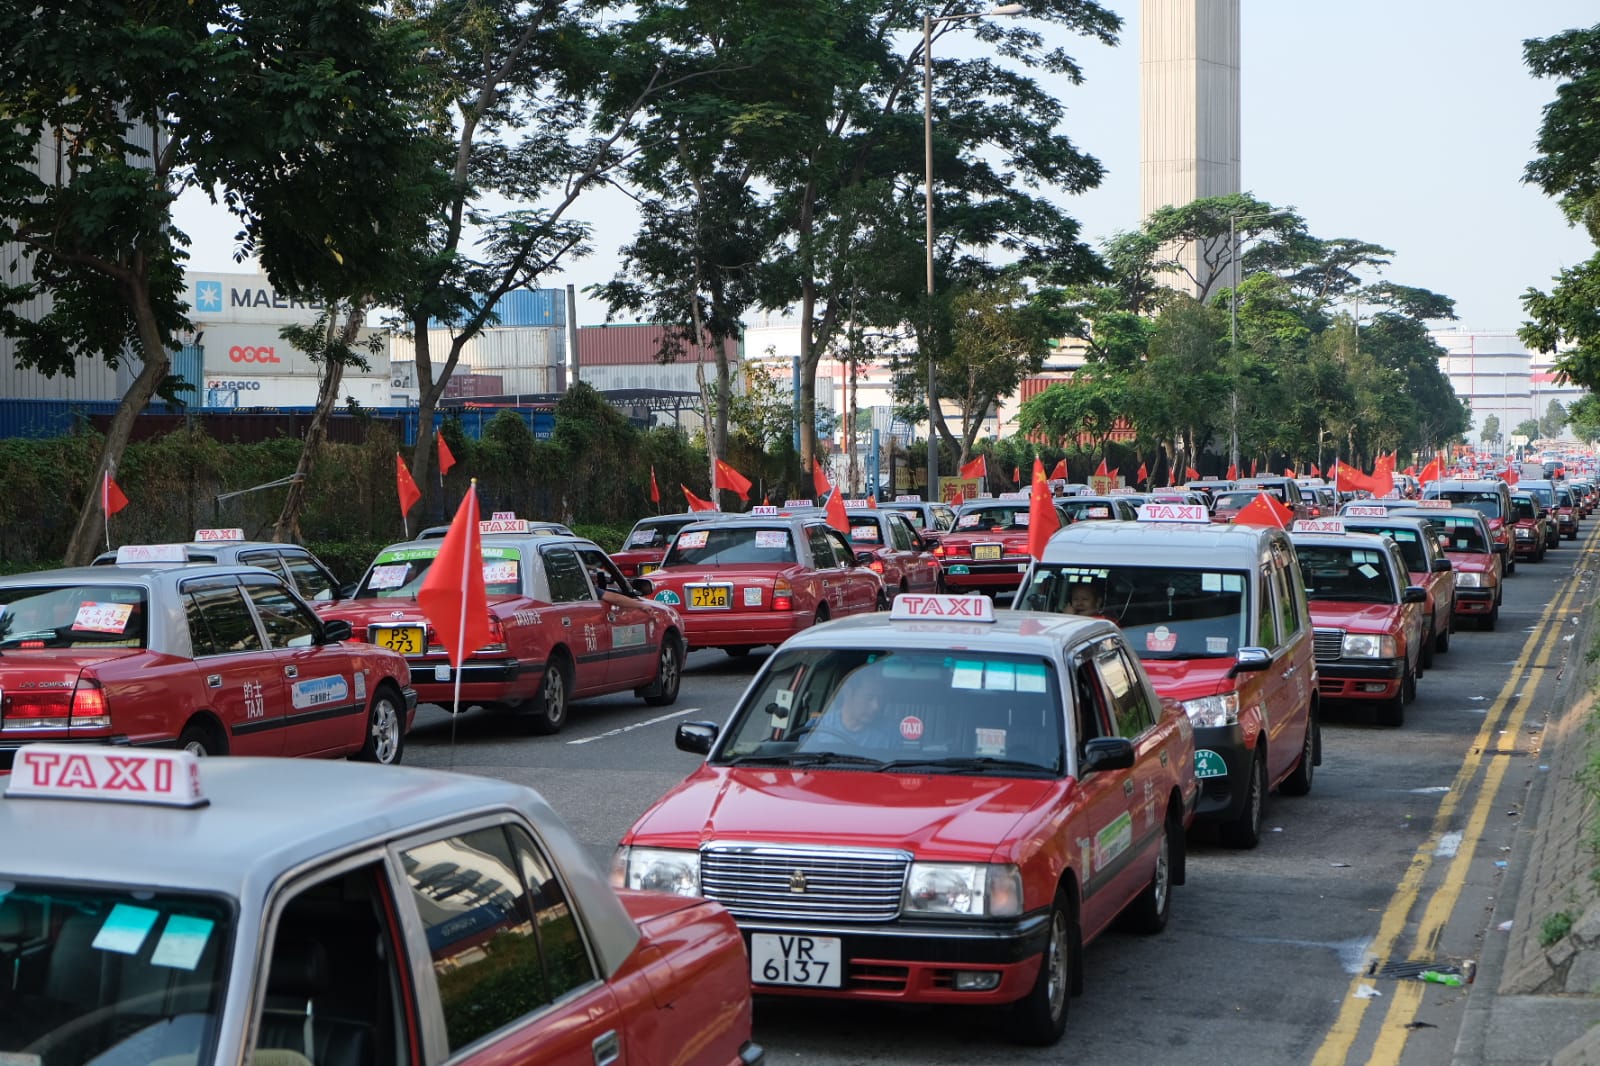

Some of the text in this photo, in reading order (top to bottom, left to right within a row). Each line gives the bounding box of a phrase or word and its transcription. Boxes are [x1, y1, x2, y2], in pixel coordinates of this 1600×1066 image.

[229, 346, 281, 363] OOCL
[754, 507, 775, 515] TAXI
[1146, 505, 1202, 519] TAXI
[1351, 507, 1385, 516] TAXI
[480, 521, 524, 532] TAXI
[1299, 521, 1340, 532] TAXI
[199, 529, 237, 540] TAXI
[702, 588, 717, 597] GY
[695, 596, 725, 606] 7148
[902, 597, 982, 616] TAXI
[391, 628, 409, 641] PS
[243, 680, 262, 699] 的士
[244, 698, 264, 718] TAXI
[903, 721, 922, 734] TAXI
[1197, 758, 1208, 769] 4
[25, 752, 172, 793] TAXI
[778, 936, 815, 960] VR
[763, 958, 830, 984] 6137
